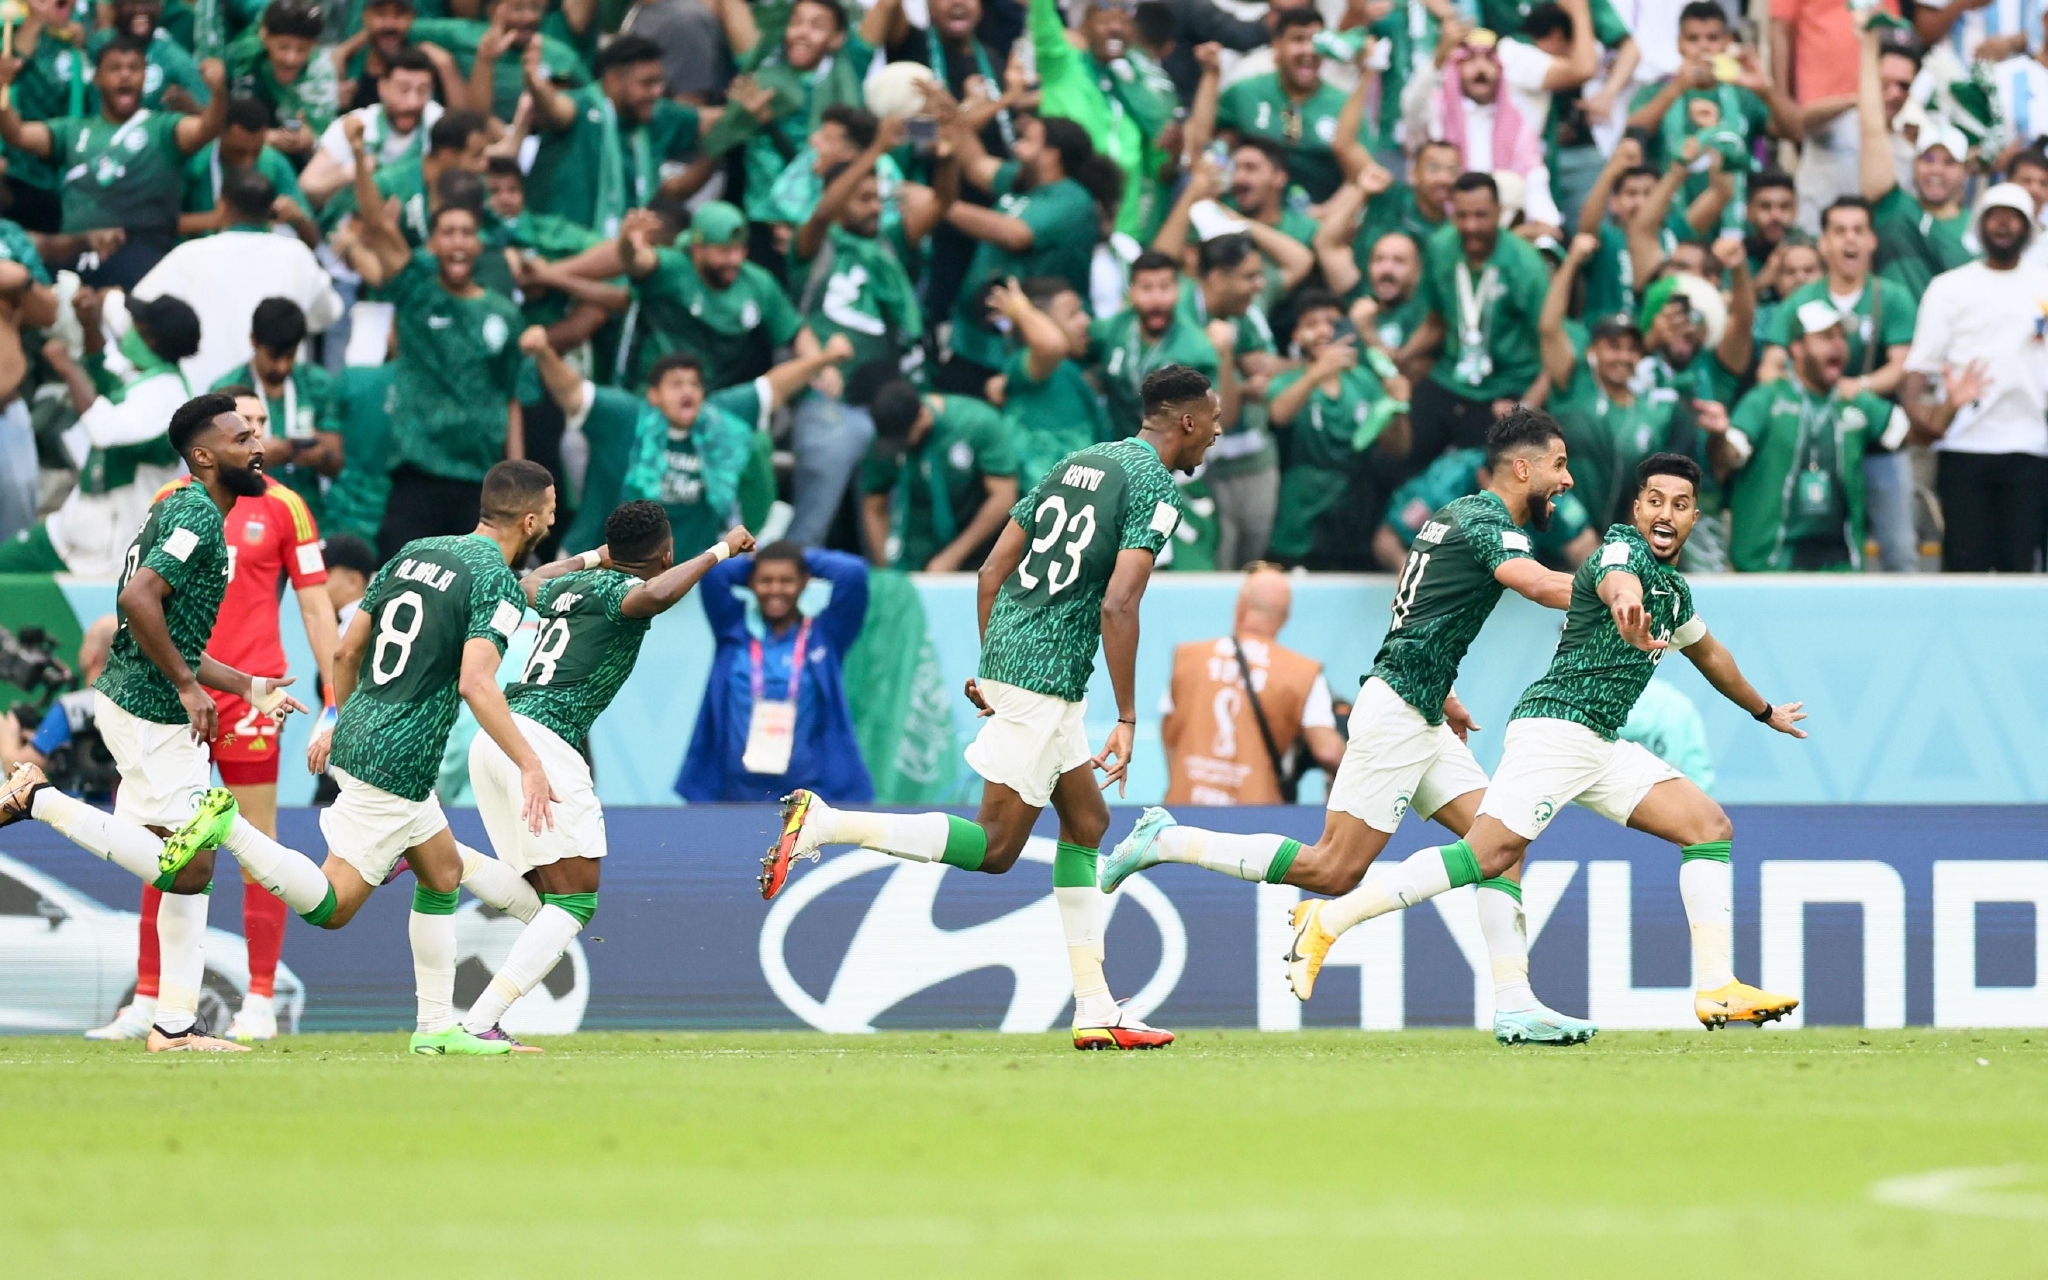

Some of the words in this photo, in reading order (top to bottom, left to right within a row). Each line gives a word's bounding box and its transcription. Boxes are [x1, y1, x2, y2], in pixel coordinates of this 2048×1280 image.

[1061, 464, 1106, 492] KANNO
[1018, 495, 1096, 596] 23
[1391, 550, 1431, 632] 11
[372, 590, 424, 685] 8
[520, 617, 571, 686] 18
[1648, 623, 1671, 667] 10
